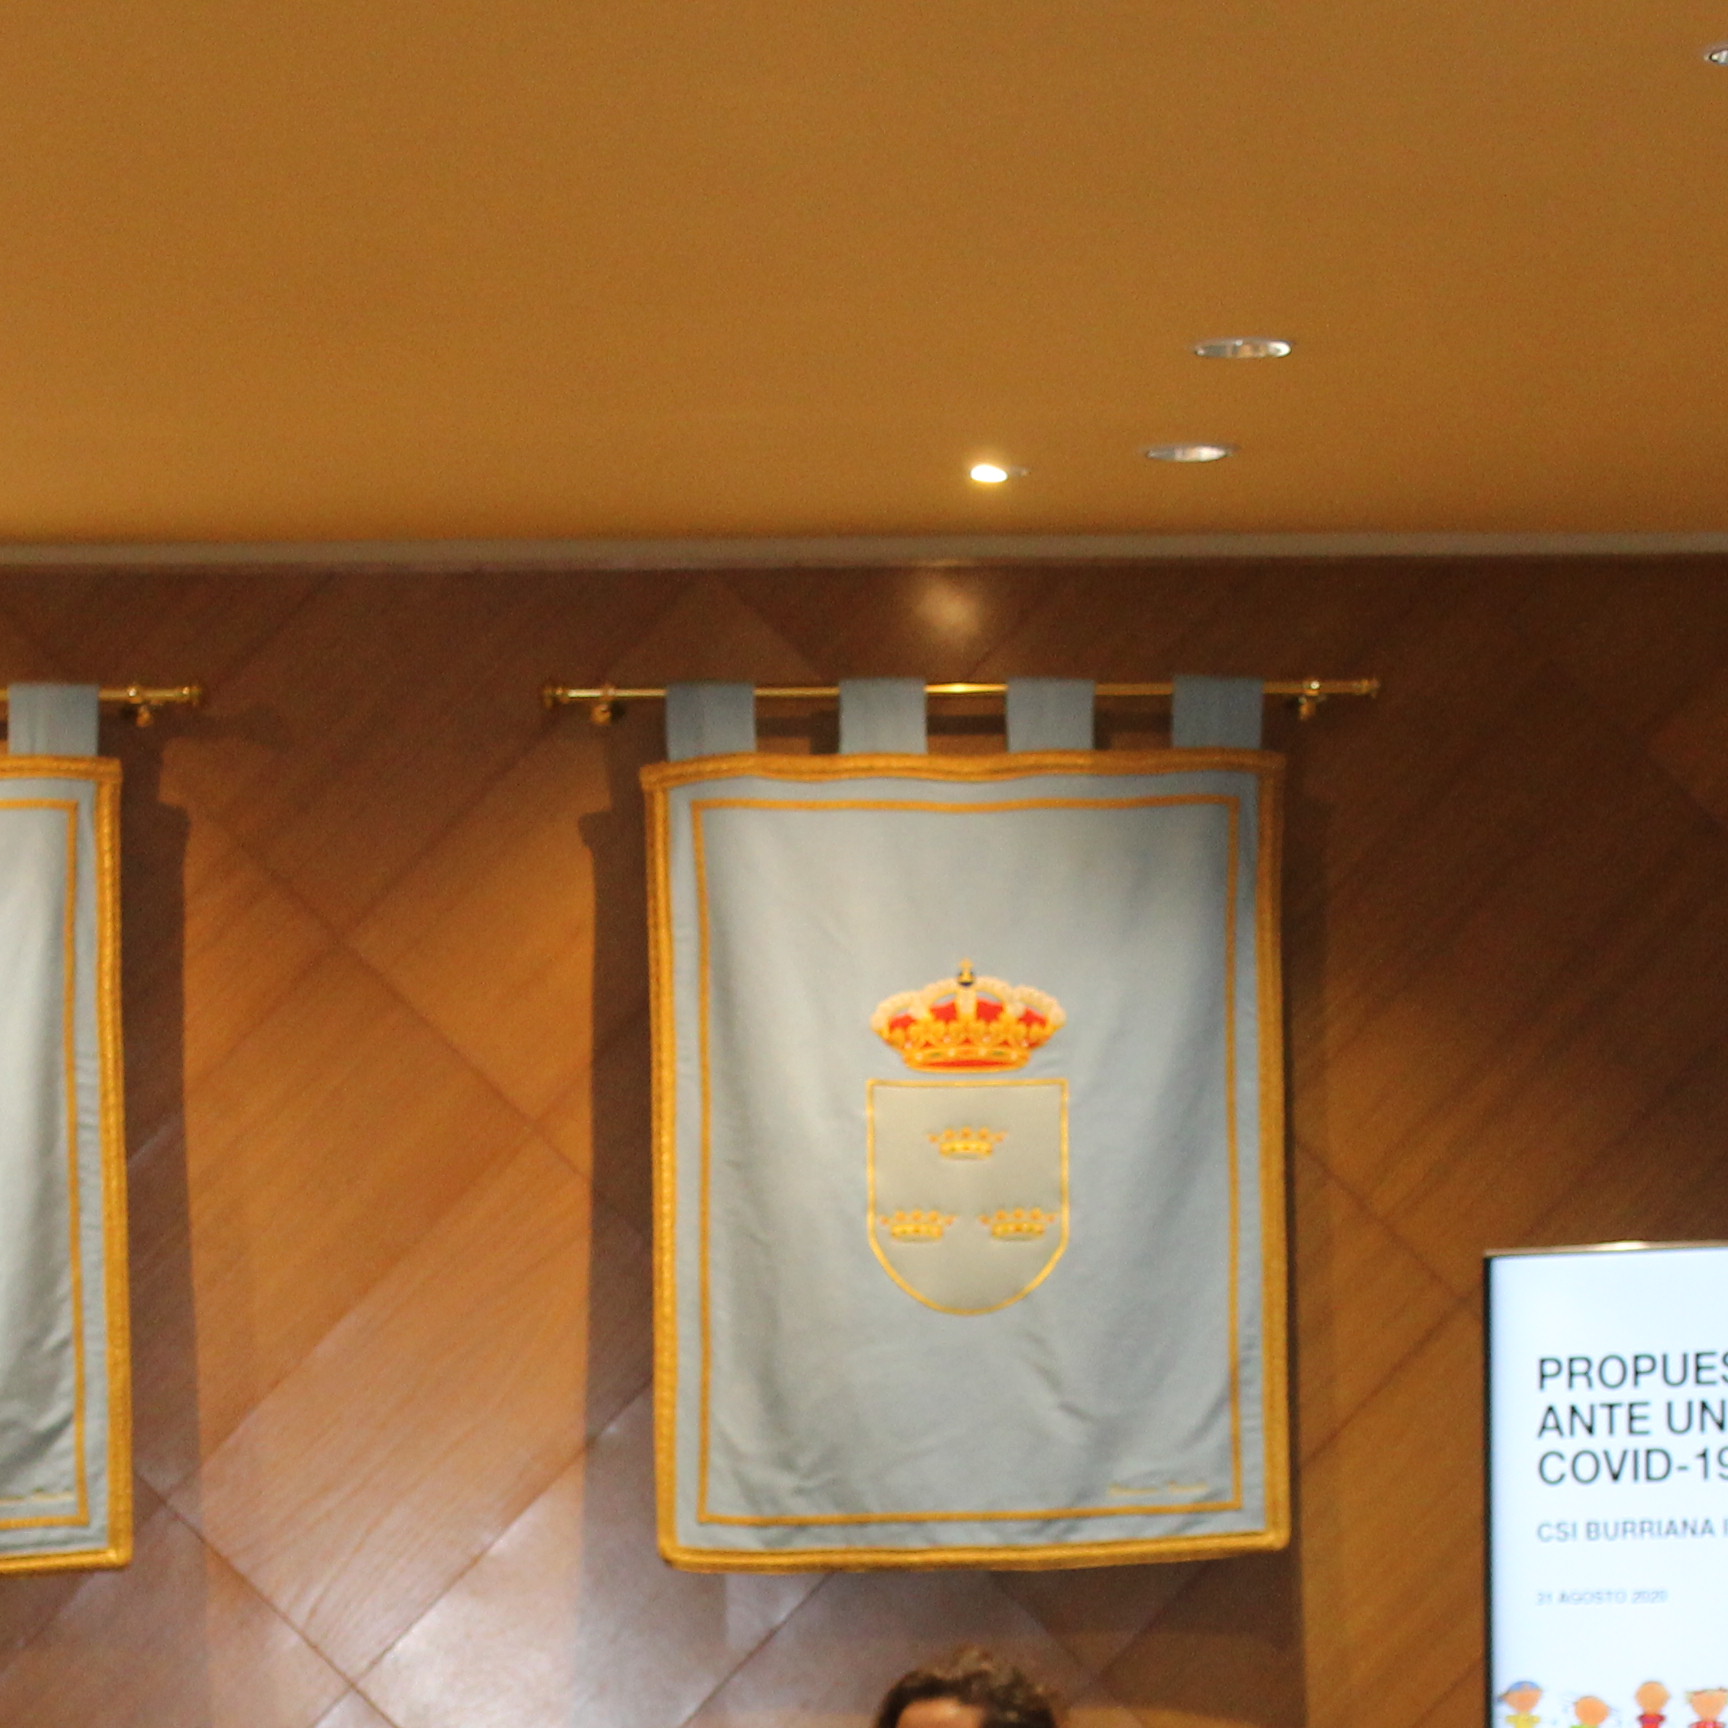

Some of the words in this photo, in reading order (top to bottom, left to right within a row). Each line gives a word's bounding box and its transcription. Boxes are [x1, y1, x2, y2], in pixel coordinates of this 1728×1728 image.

[1537, 1400, 1652, 1440] ANTE
[1666, 1397, 1728, 1436] UN
[1536, 1519, 1579, 1544] CSI
[1585, 1515, 1716, 1543] BURRIANA
